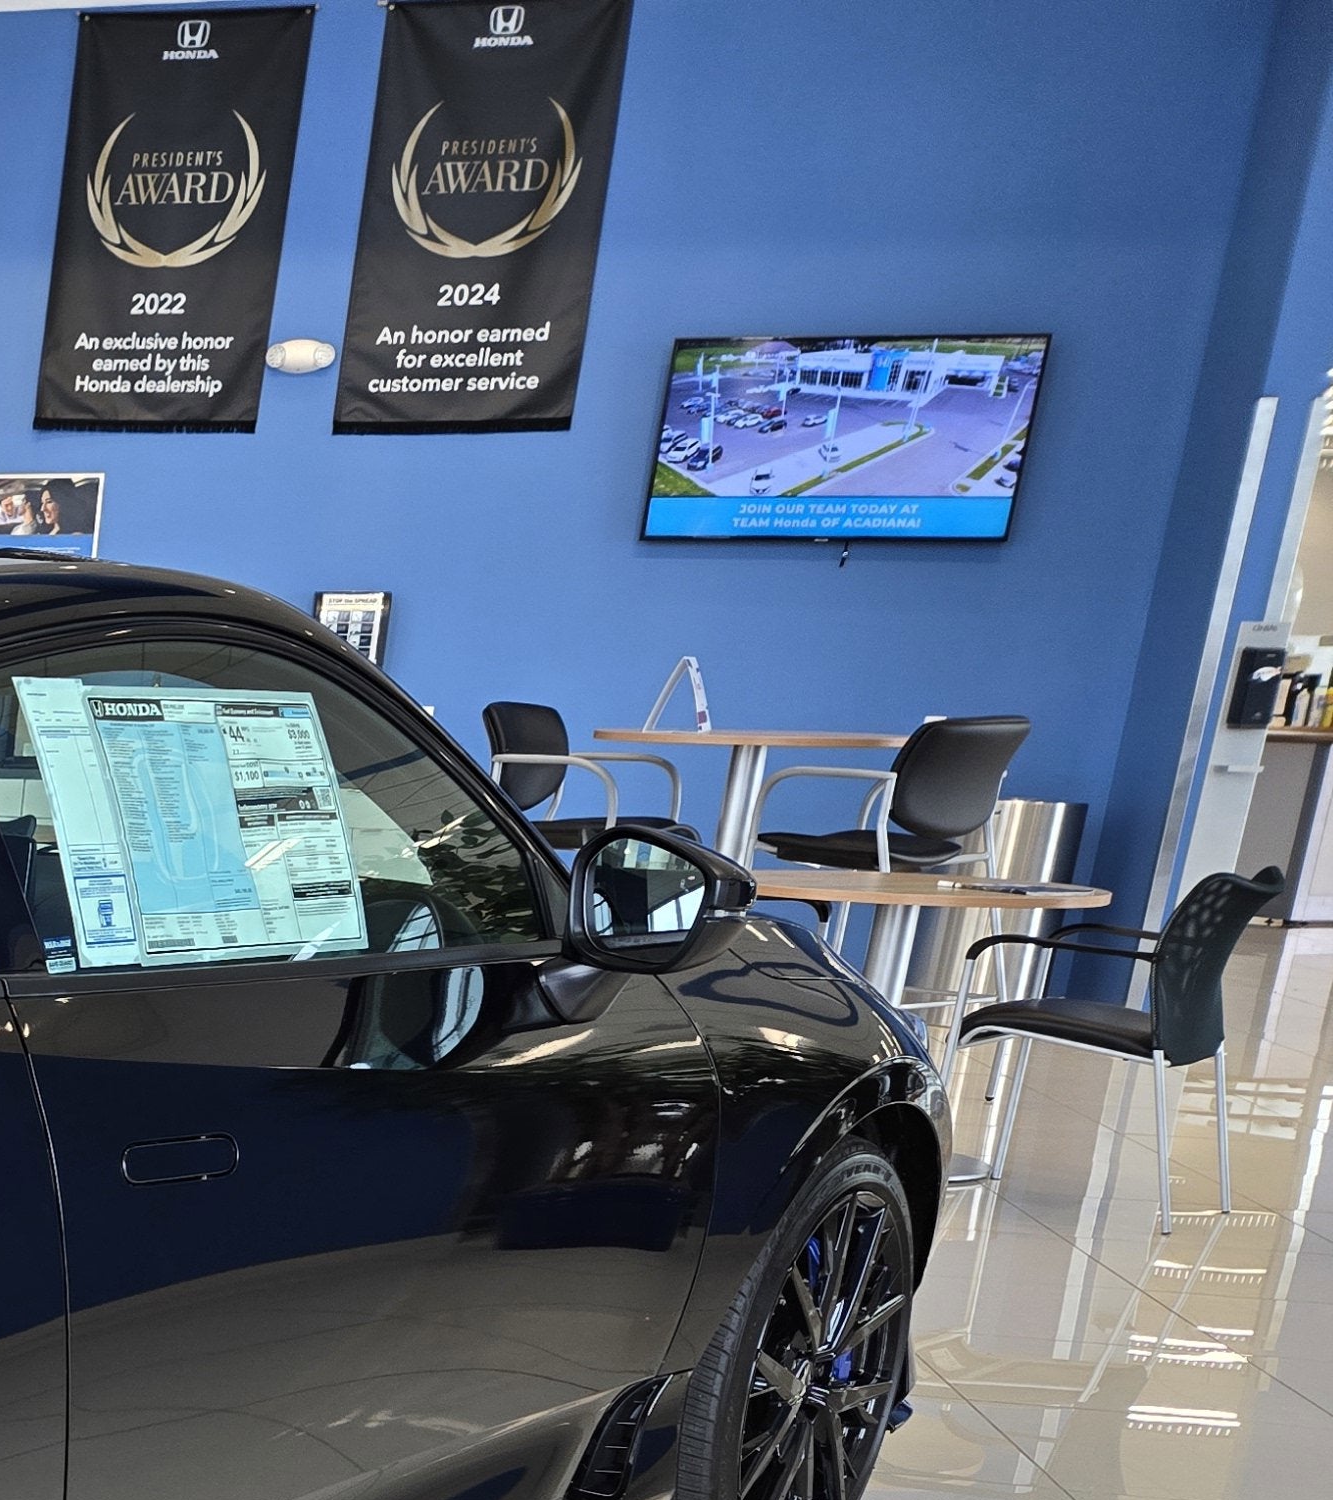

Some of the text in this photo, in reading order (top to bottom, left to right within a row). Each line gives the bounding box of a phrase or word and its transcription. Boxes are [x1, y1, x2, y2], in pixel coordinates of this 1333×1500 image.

[472, 35, 534, 48] HONDA
[162, 49, 219, 60] HONDA
[441, 137, 538, 156] PRESIDENT'S
[132, 150, 223, 168] PRESIDENT'S
[421, 158, 549, 195] AWARD
[114, 171, 234, 206] AWARD
[130, 292, 187, 315] 2022
[436, 282, 501, 306] 2024
[74, 331, 235, 350] An exclusive honor
[375, 320, 551, 345] An honor earned
[92, 353, 211, 376] earned by this
[395, 346, 525, 369] for excellent
[74, 374, 223, 399] Honda dealership
[368, 371, 540, 393] customer service
[739, 504, 920, 514] JOIN OUR TEAM TODAY AT
[733, 517, 922, 528] TEAM Honda OF ACADIANA!
[103, 702, 162, 717] HONDA
[228, 726, 245, 743] 44
[287, 729, 311, 740] $3,000
[234, 771, 260, 782] $1,100
